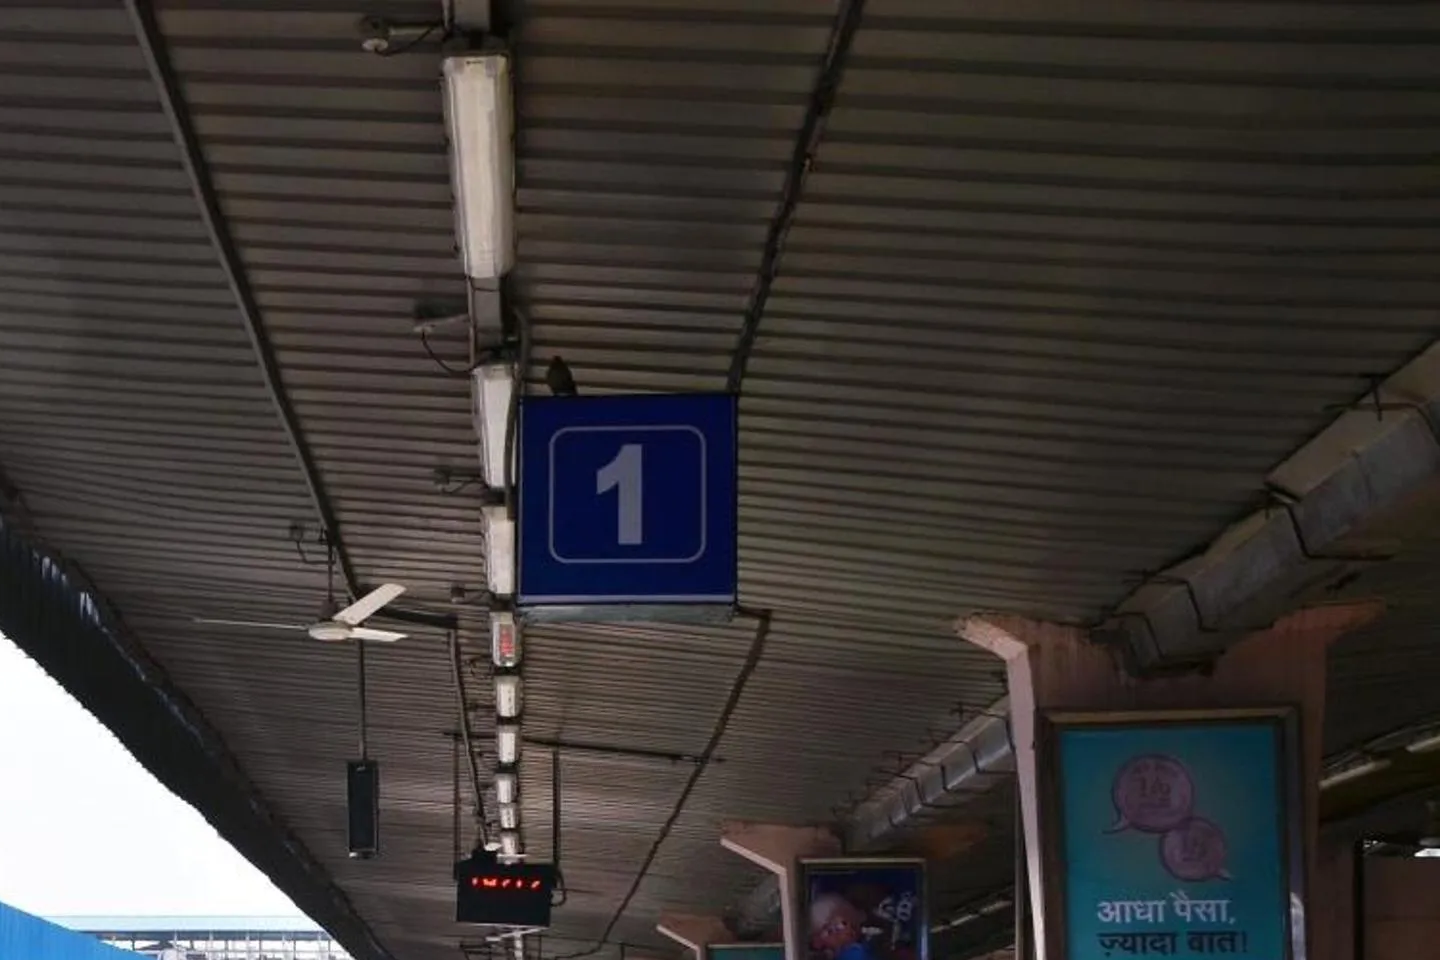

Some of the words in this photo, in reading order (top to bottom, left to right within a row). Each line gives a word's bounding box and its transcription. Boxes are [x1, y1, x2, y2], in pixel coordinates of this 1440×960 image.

[596, 444, 642, 545] 1
[1096, 899, 1166, 924] आधा
[1171, 891, 1236, 925] पैसा,
